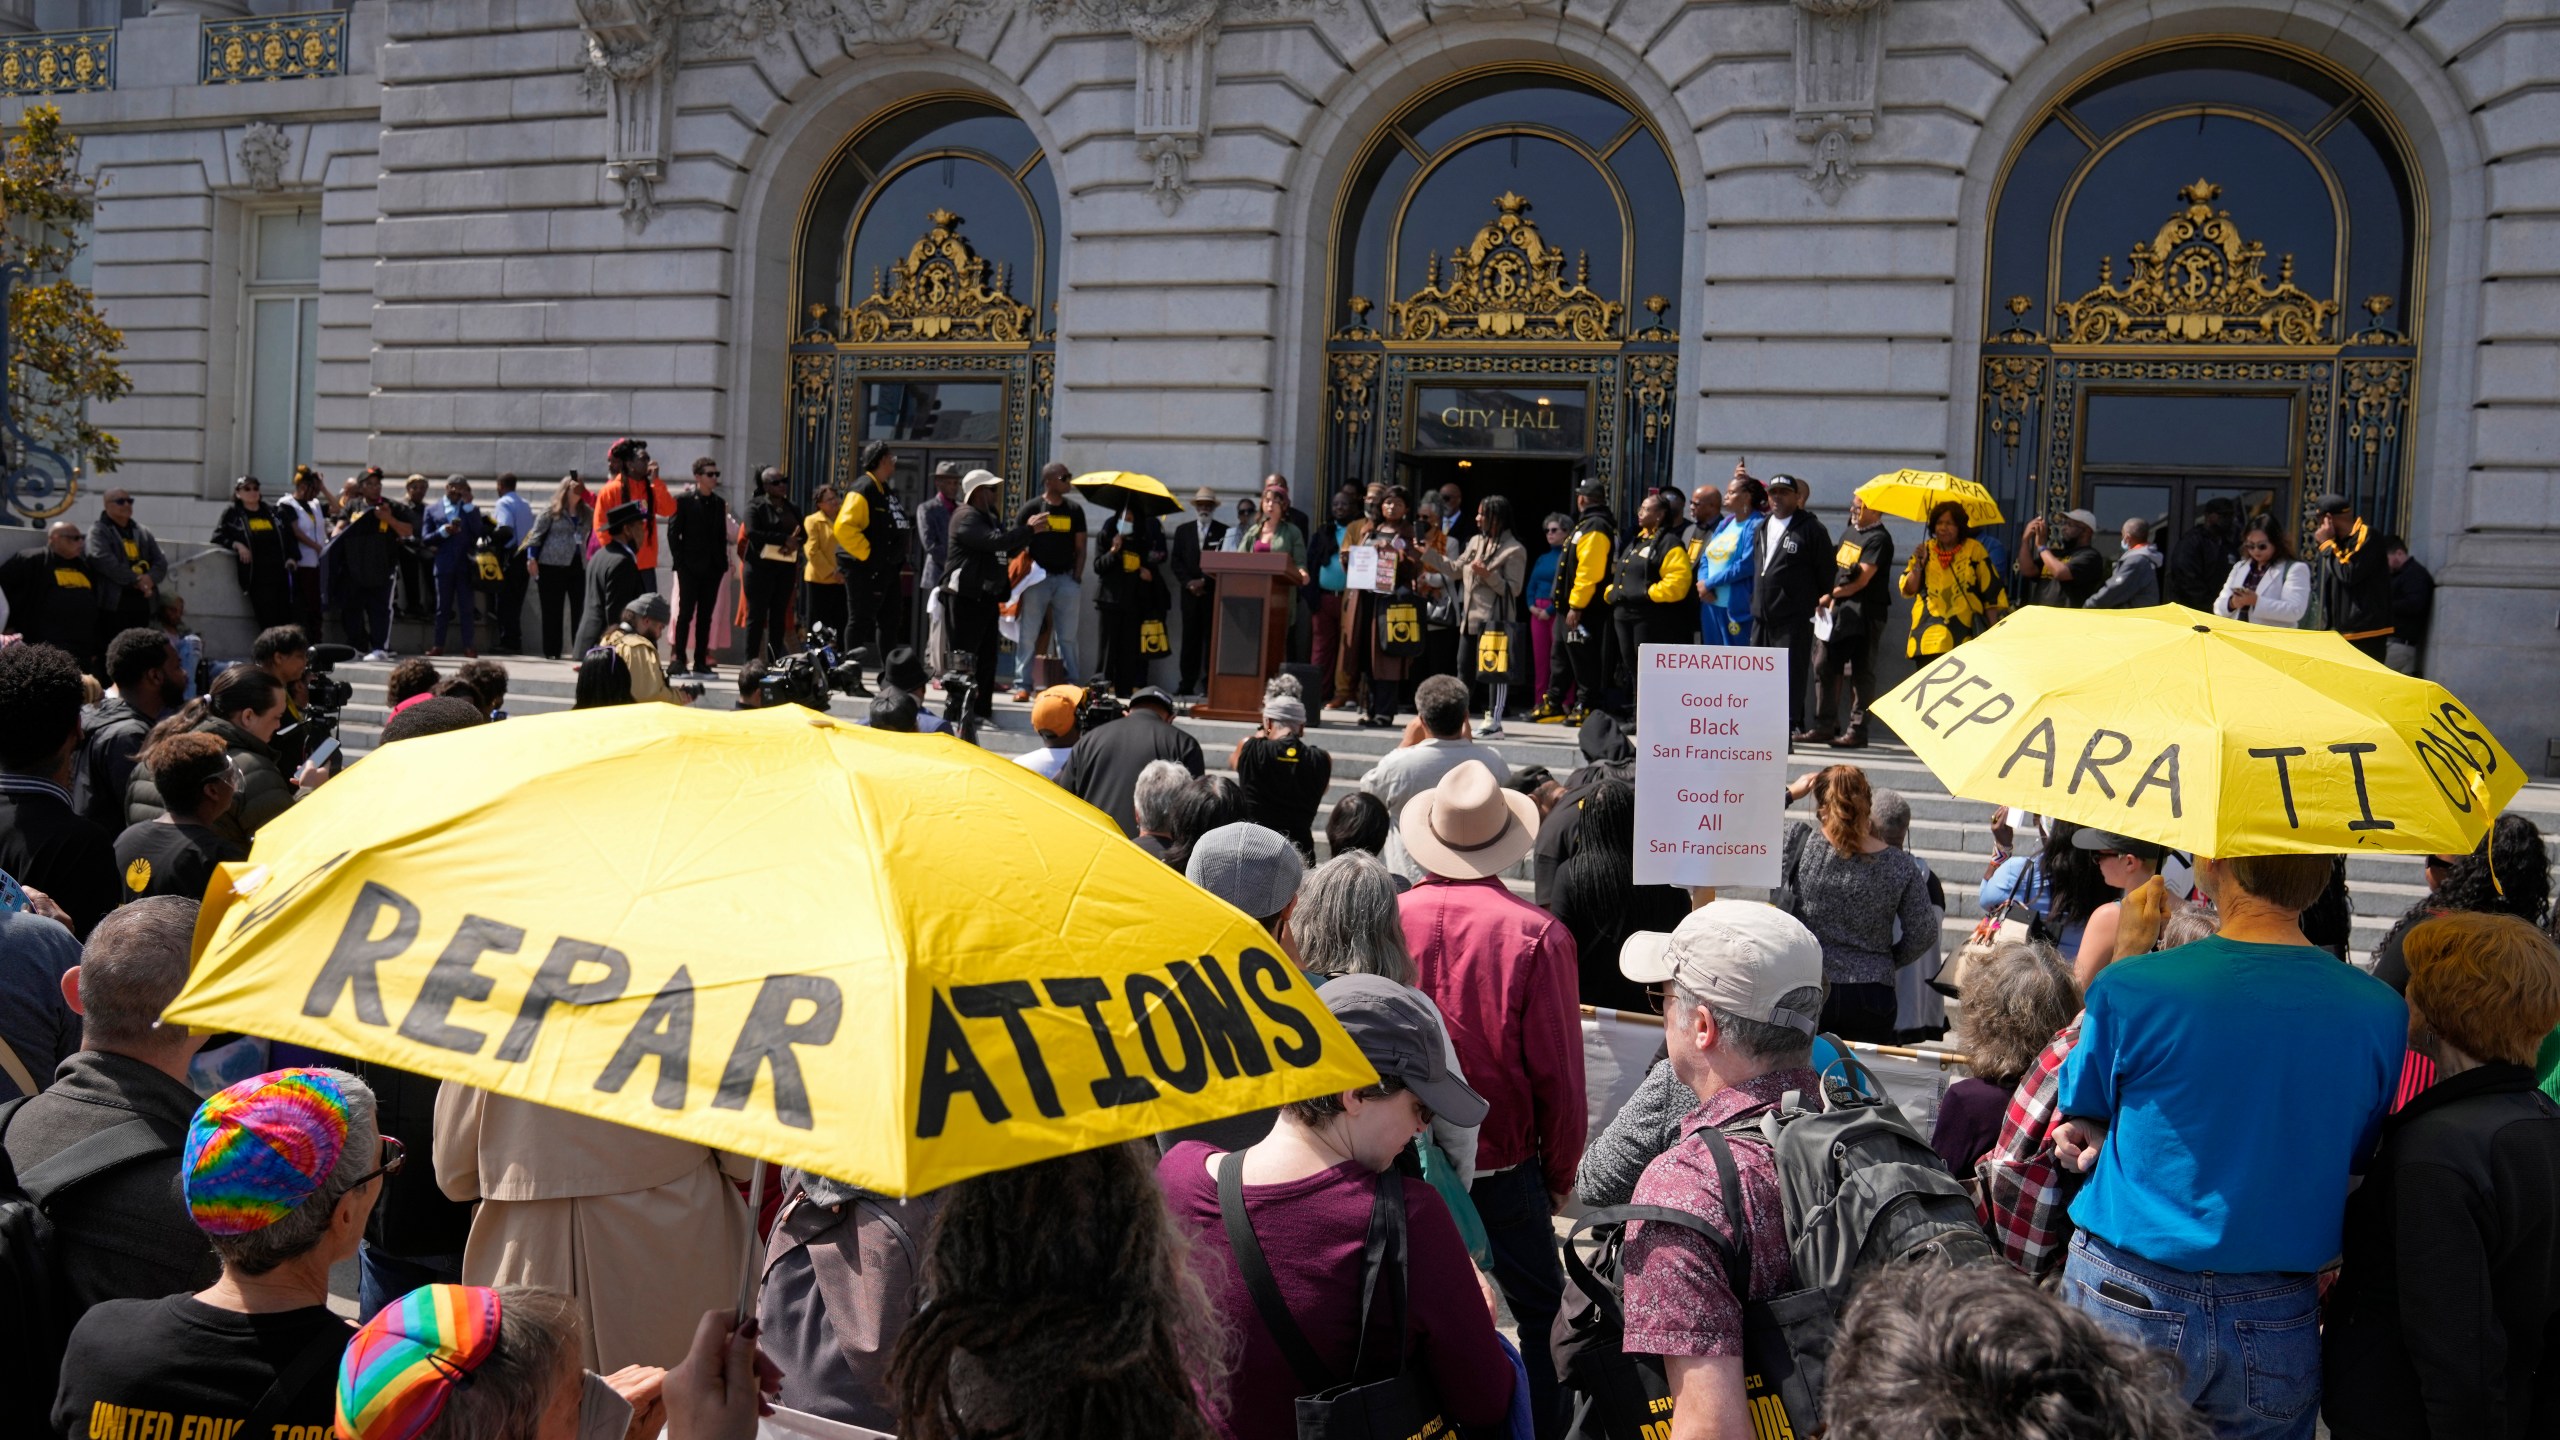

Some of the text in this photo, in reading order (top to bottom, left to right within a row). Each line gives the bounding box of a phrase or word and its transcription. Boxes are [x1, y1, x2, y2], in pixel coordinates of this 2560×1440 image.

[1441, 407, 1560, 429] CITY HALL
[1656, 653, 1775, 672] REPARATIONS
[1681, 693, 1749, 708] Good for
[1690, 718, 1739, 736] Black
[1653, 744, 1772, 761] San Franciscans
[1677, 789, 1745, 804] Good for
[1698, 814, 1722, 831] All
[1650, 840, 1767, 855] San Franciscans
[88, 1400, 173, 1440] UNITED
